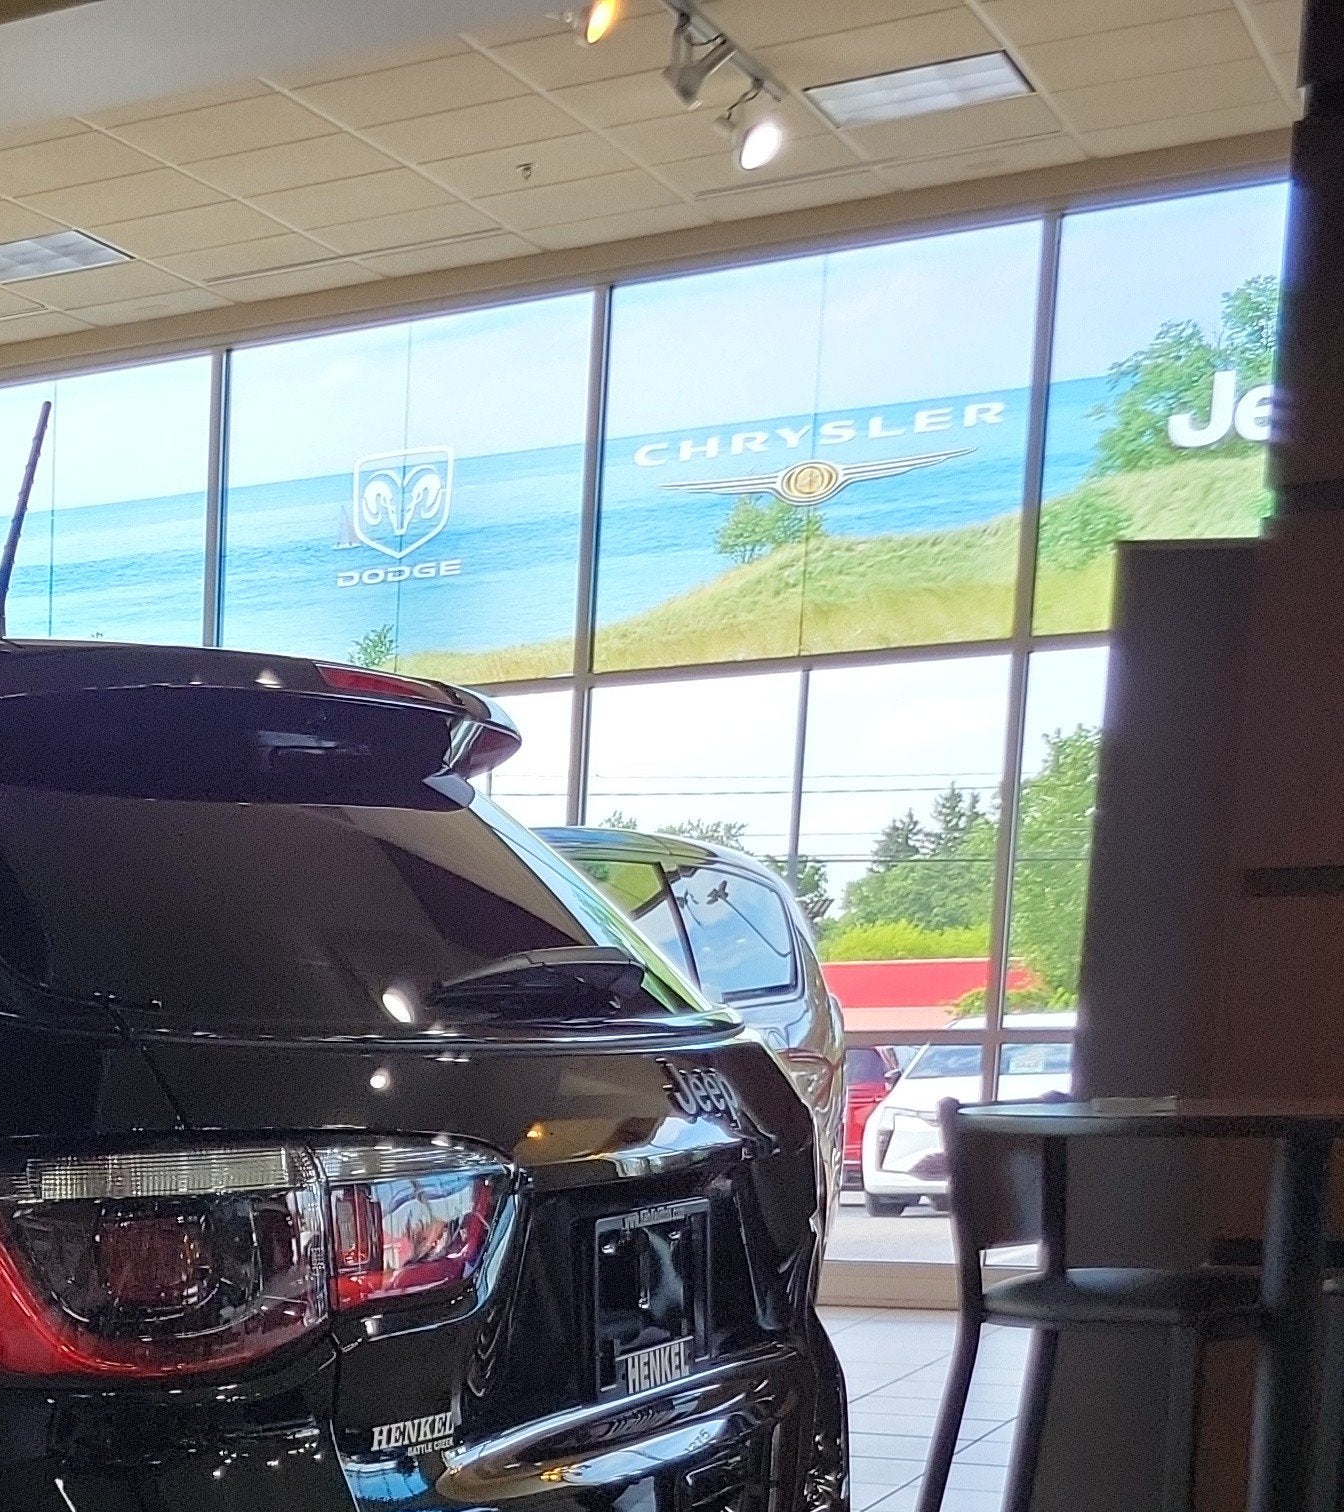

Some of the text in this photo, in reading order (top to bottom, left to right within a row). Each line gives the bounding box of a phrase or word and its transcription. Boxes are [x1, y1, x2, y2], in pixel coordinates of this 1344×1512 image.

[633, 401, 1006, 467] CHRYSLER
[336, 559, 462, 588] DODGE
[660, 1060, 742, 1130] Jeep
[627, 1341, 690, 1394] HENKEL
[371, 1412, 455, 1451] HENKEL
